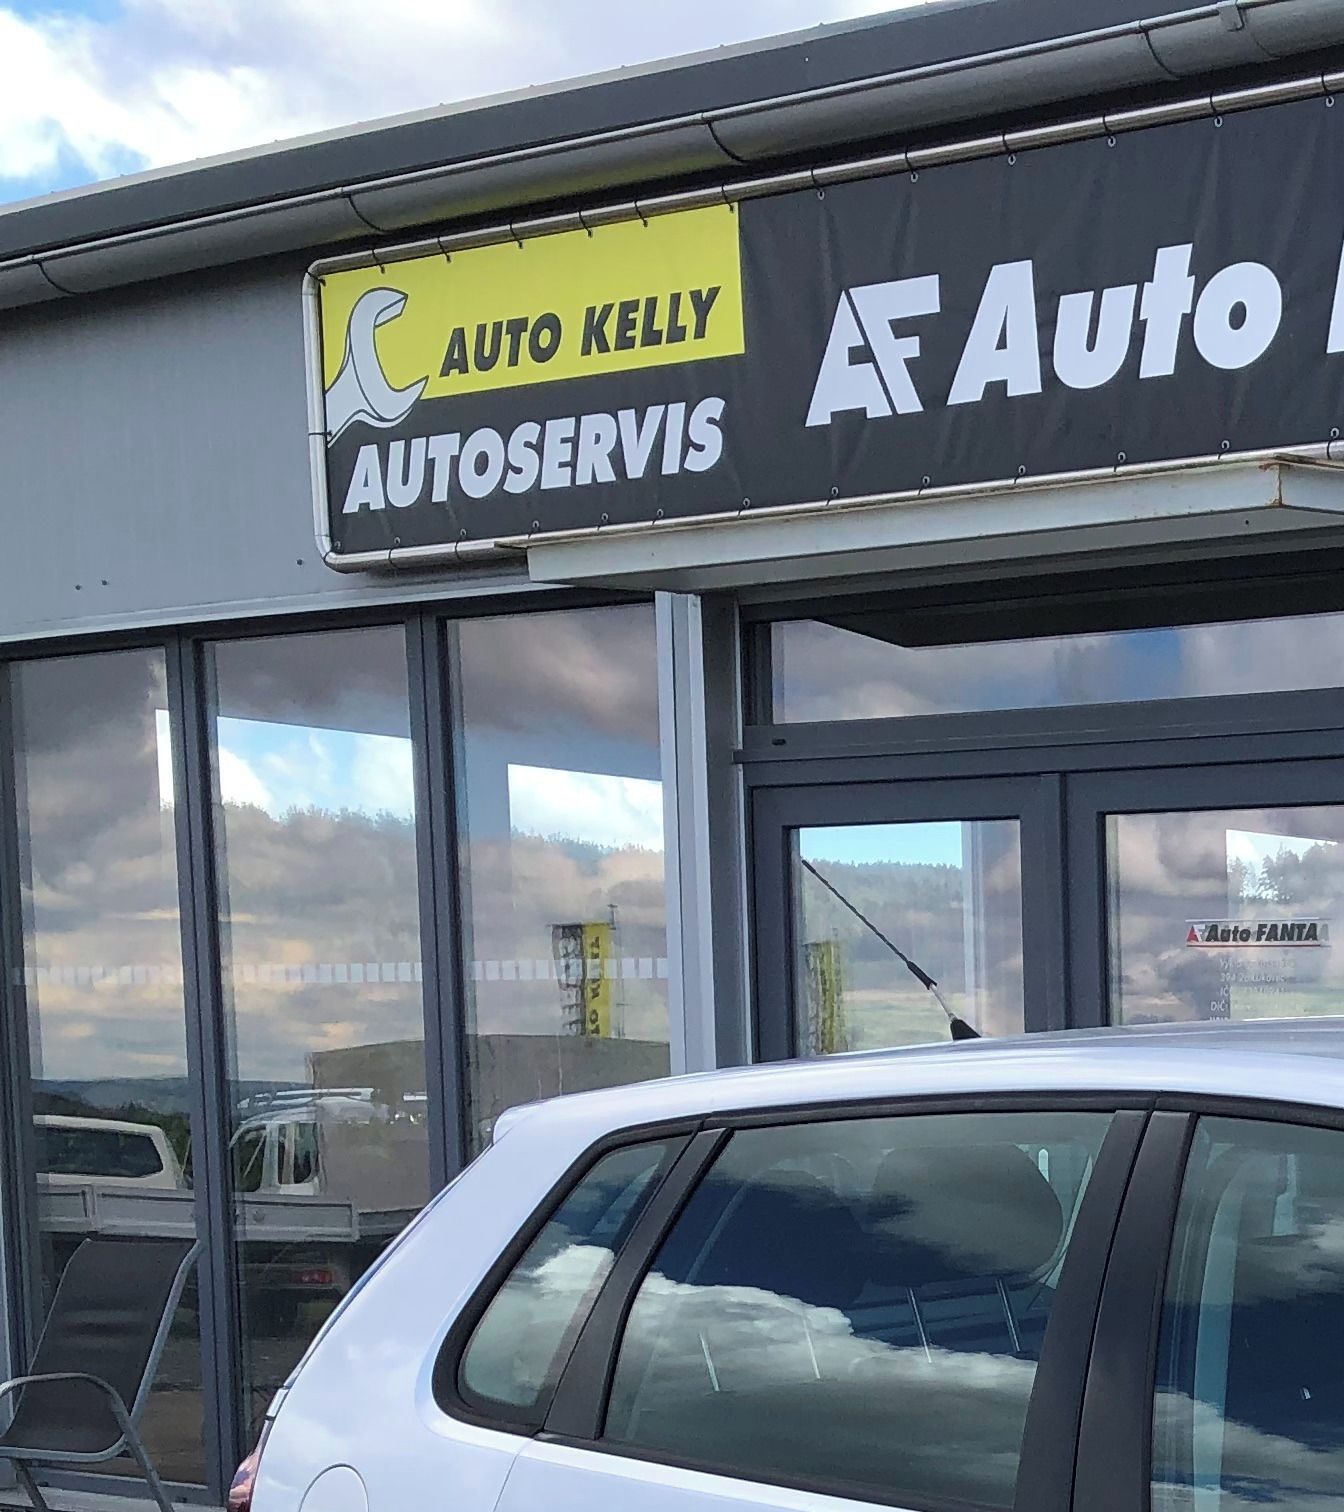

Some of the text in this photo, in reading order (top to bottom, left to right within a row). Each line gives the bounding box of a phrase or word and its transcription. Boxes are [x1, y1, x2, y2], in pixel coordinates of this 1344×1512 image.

[438, 285, 721, 378] AUTO KELLY
[946, 241, 1283, 405] Auto
[341, 396, 727, 515] AUTOSERVIS
[1206, 924, 1251, 942] Auto
[1256, 923, 1318, 942] FANTA
